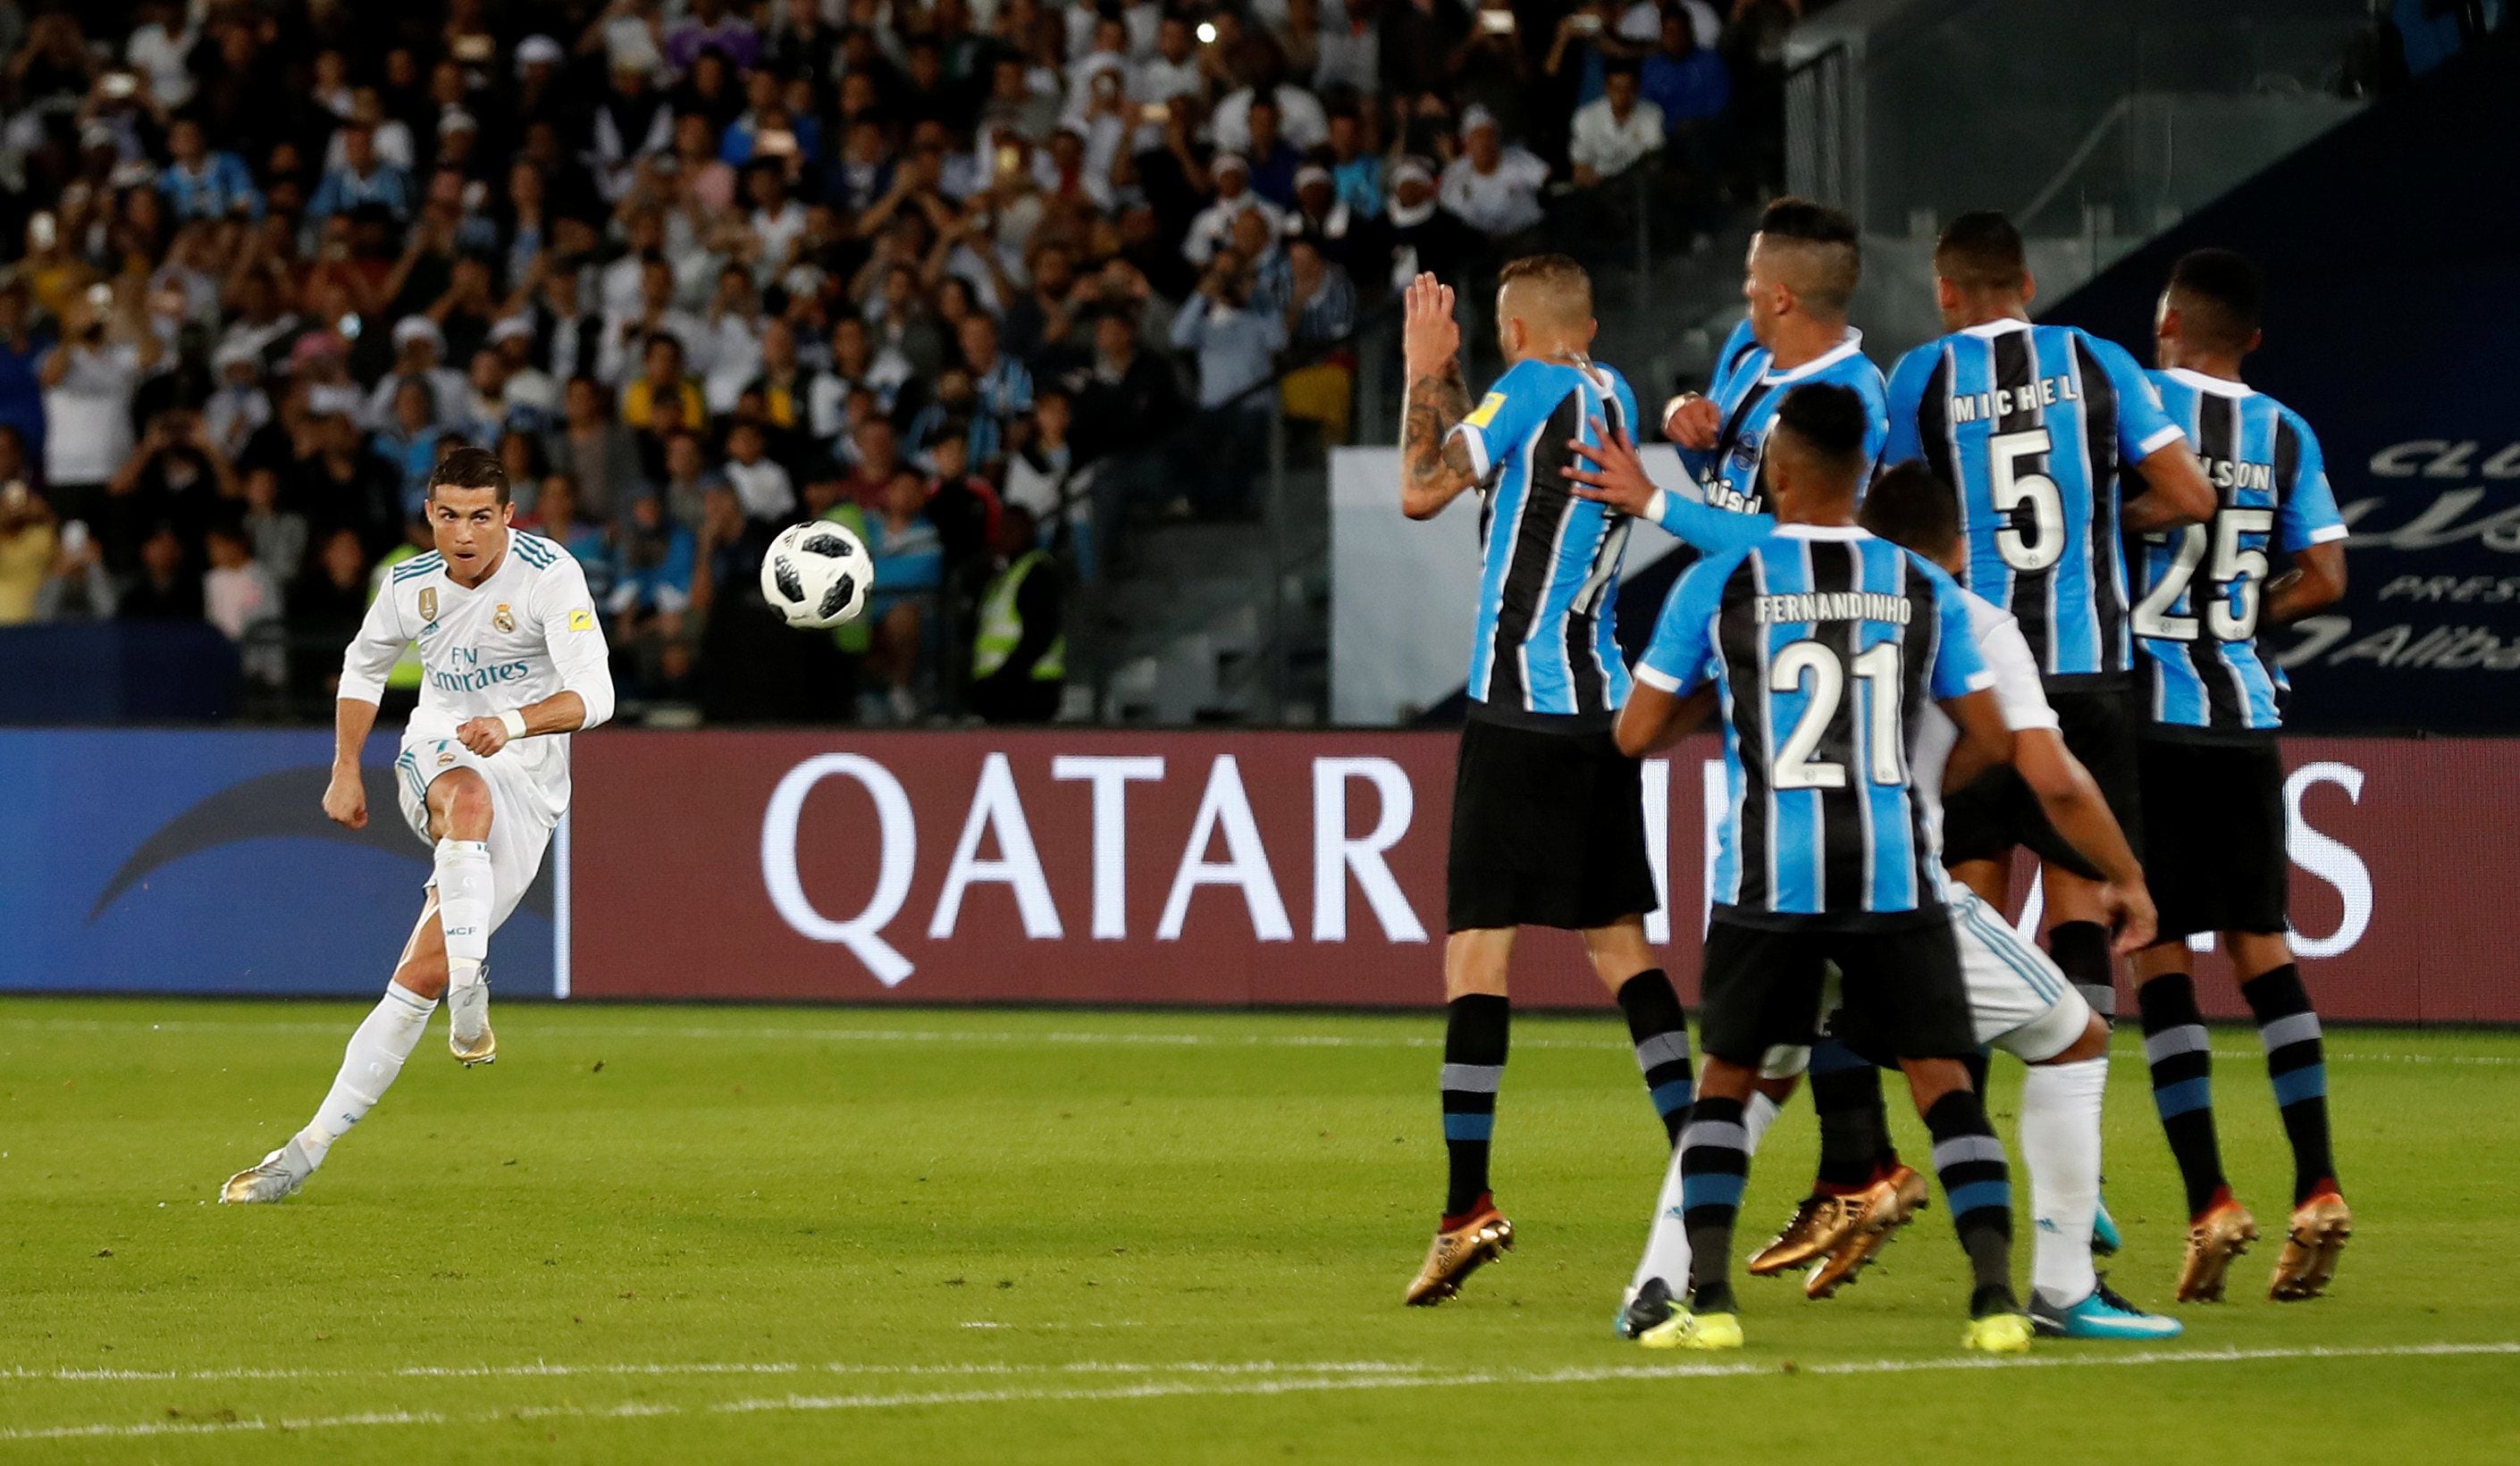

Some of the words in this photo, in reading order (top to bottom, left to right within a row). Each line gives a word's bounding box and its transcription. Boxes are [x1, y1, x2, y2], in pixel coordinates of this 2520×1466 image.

[1953, 375, 2078, 423] MICHEL
[1989, 429, 2065, 572] 5
[1753, 592, 1912, 625] FERNANDINHO
[2130, 509, 2274, 641] 25
[2377, 574, 2520, 602] PRES
[425, 659, 529, 692] Emirates
[1769, 640, 1902, 790] 21
[760, 751, 1430, 987] QATAR
